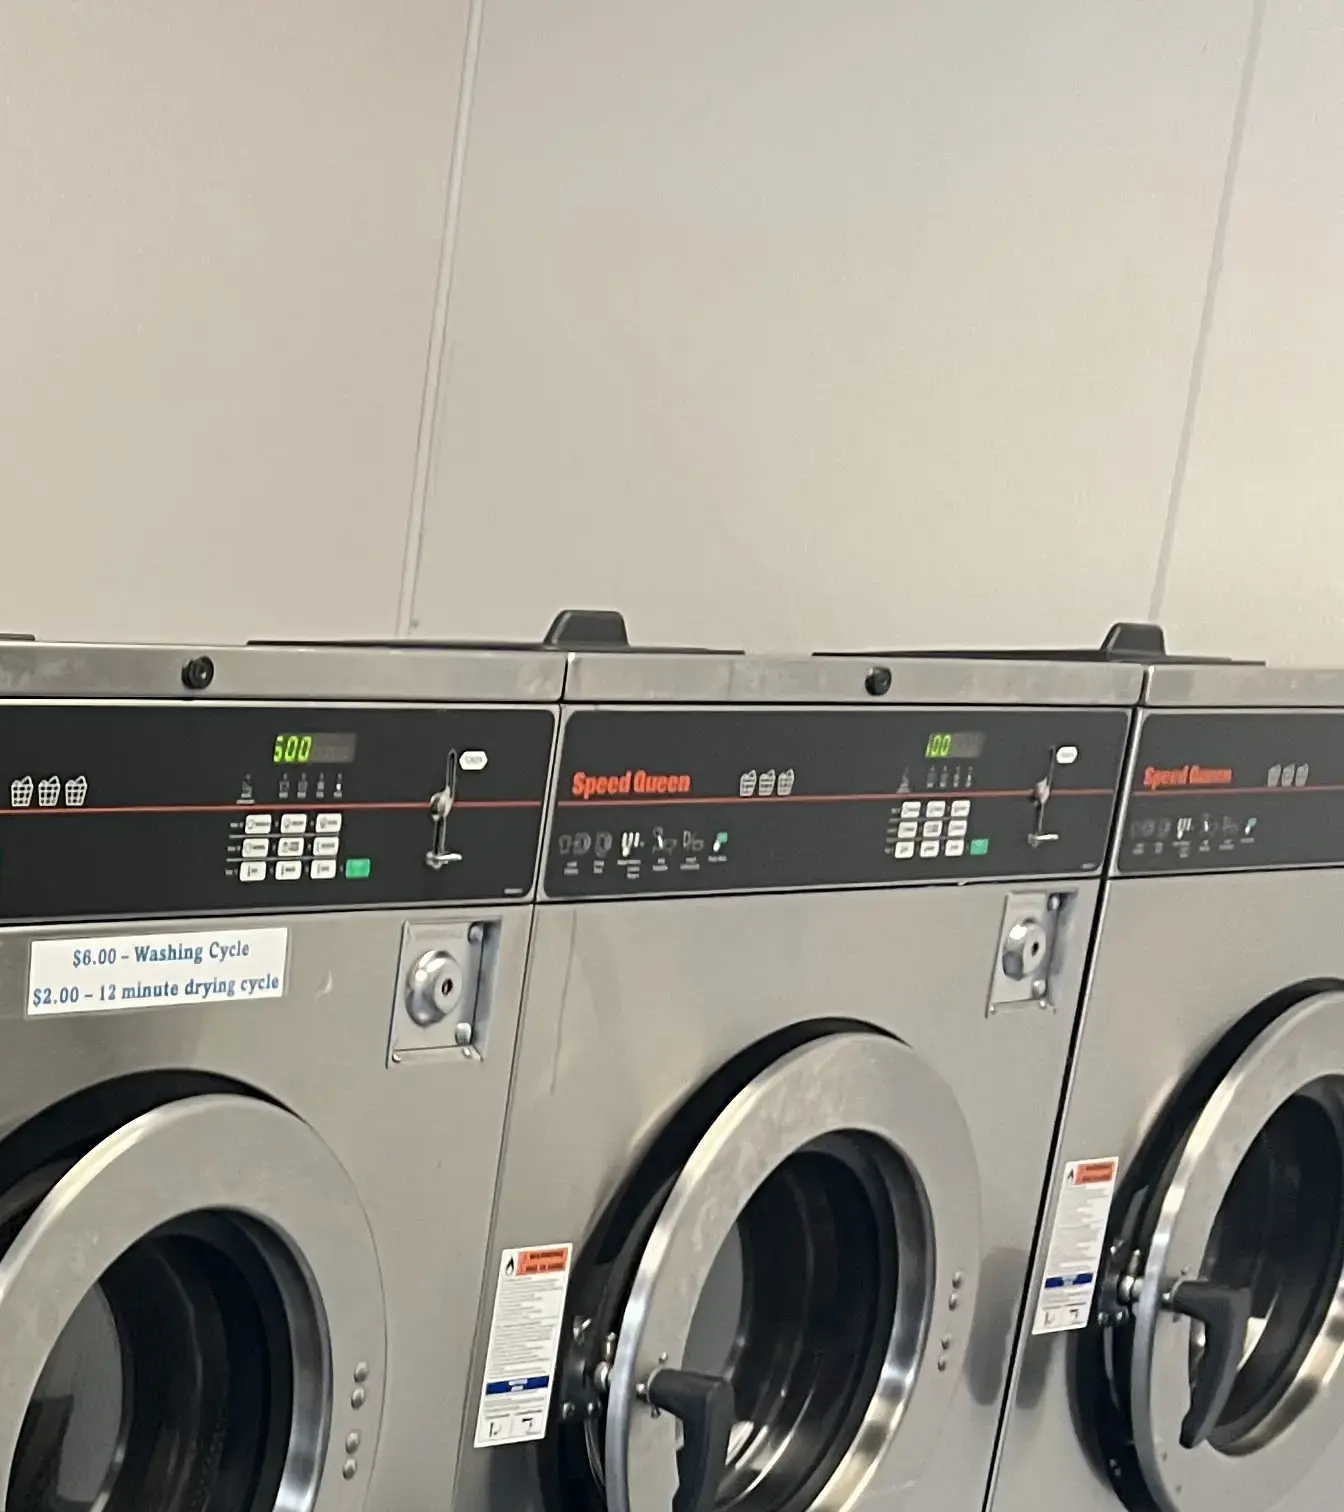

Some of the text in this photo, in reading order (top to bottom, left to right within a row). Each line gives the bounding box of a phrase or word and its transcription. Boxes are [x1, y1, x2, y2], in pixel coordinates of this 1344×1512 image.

[572, 769, 692, 800] Speed Queen
[134, 943, 204, 965] Washing
[209, 940, 250, 963] Cycle
[32, 986, 79, 1008] $2.00
[99, 984, 117, 1002] 12
[121, 980, 179, 1000] minute
[184, 977, 236, 1000] drying
[240, 973, 279, 994] cycle
